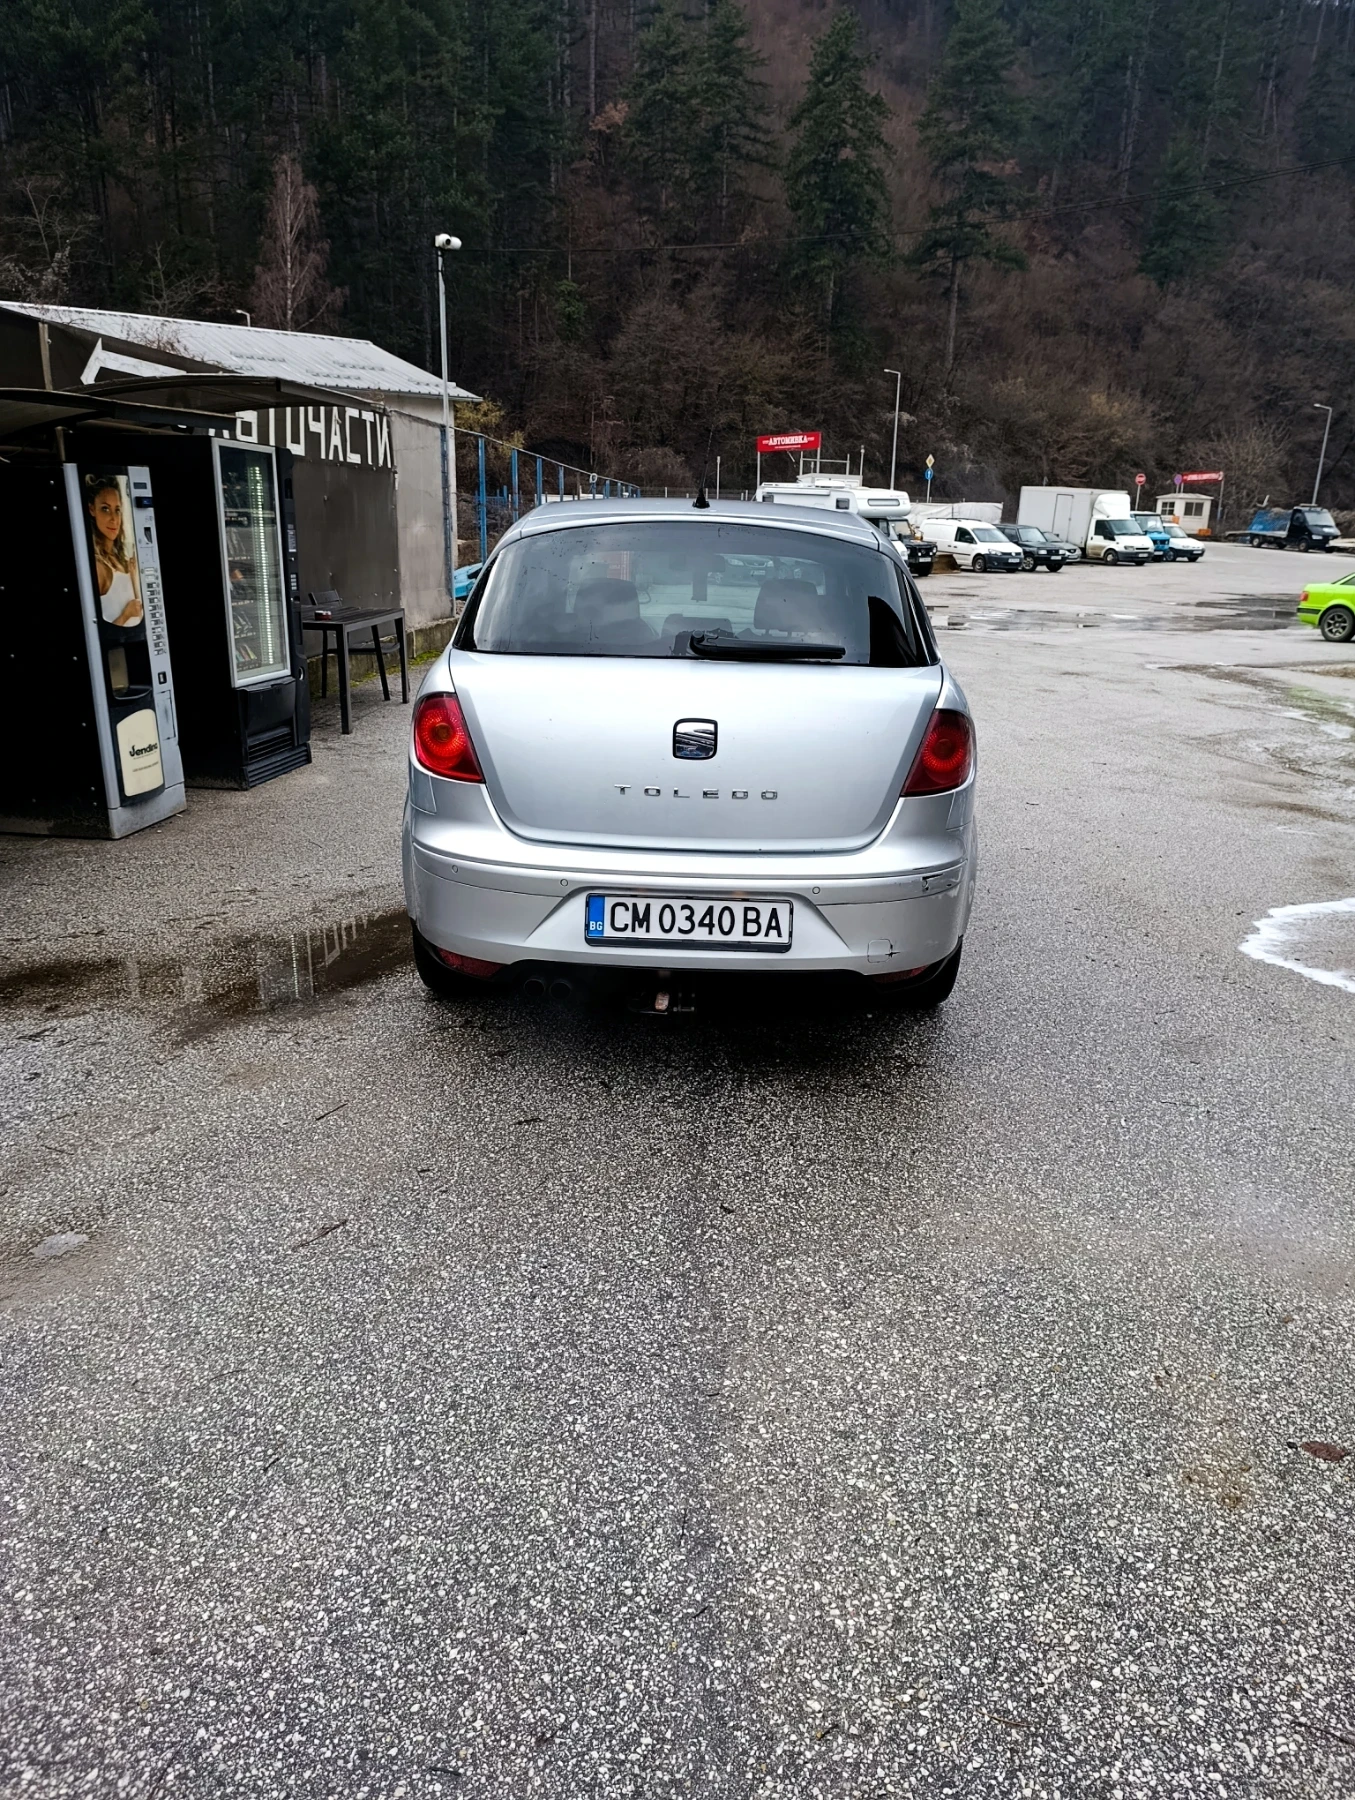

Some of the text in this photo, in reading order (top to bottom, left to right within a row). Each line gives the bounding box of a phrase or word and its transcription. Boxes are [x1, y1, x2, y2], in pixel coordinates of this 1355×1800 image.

[614, 784, 778, 801] TOLEDO
[589, 920, 603, 932] BG
[610, 902, 782, 938] CM 0340 BA
